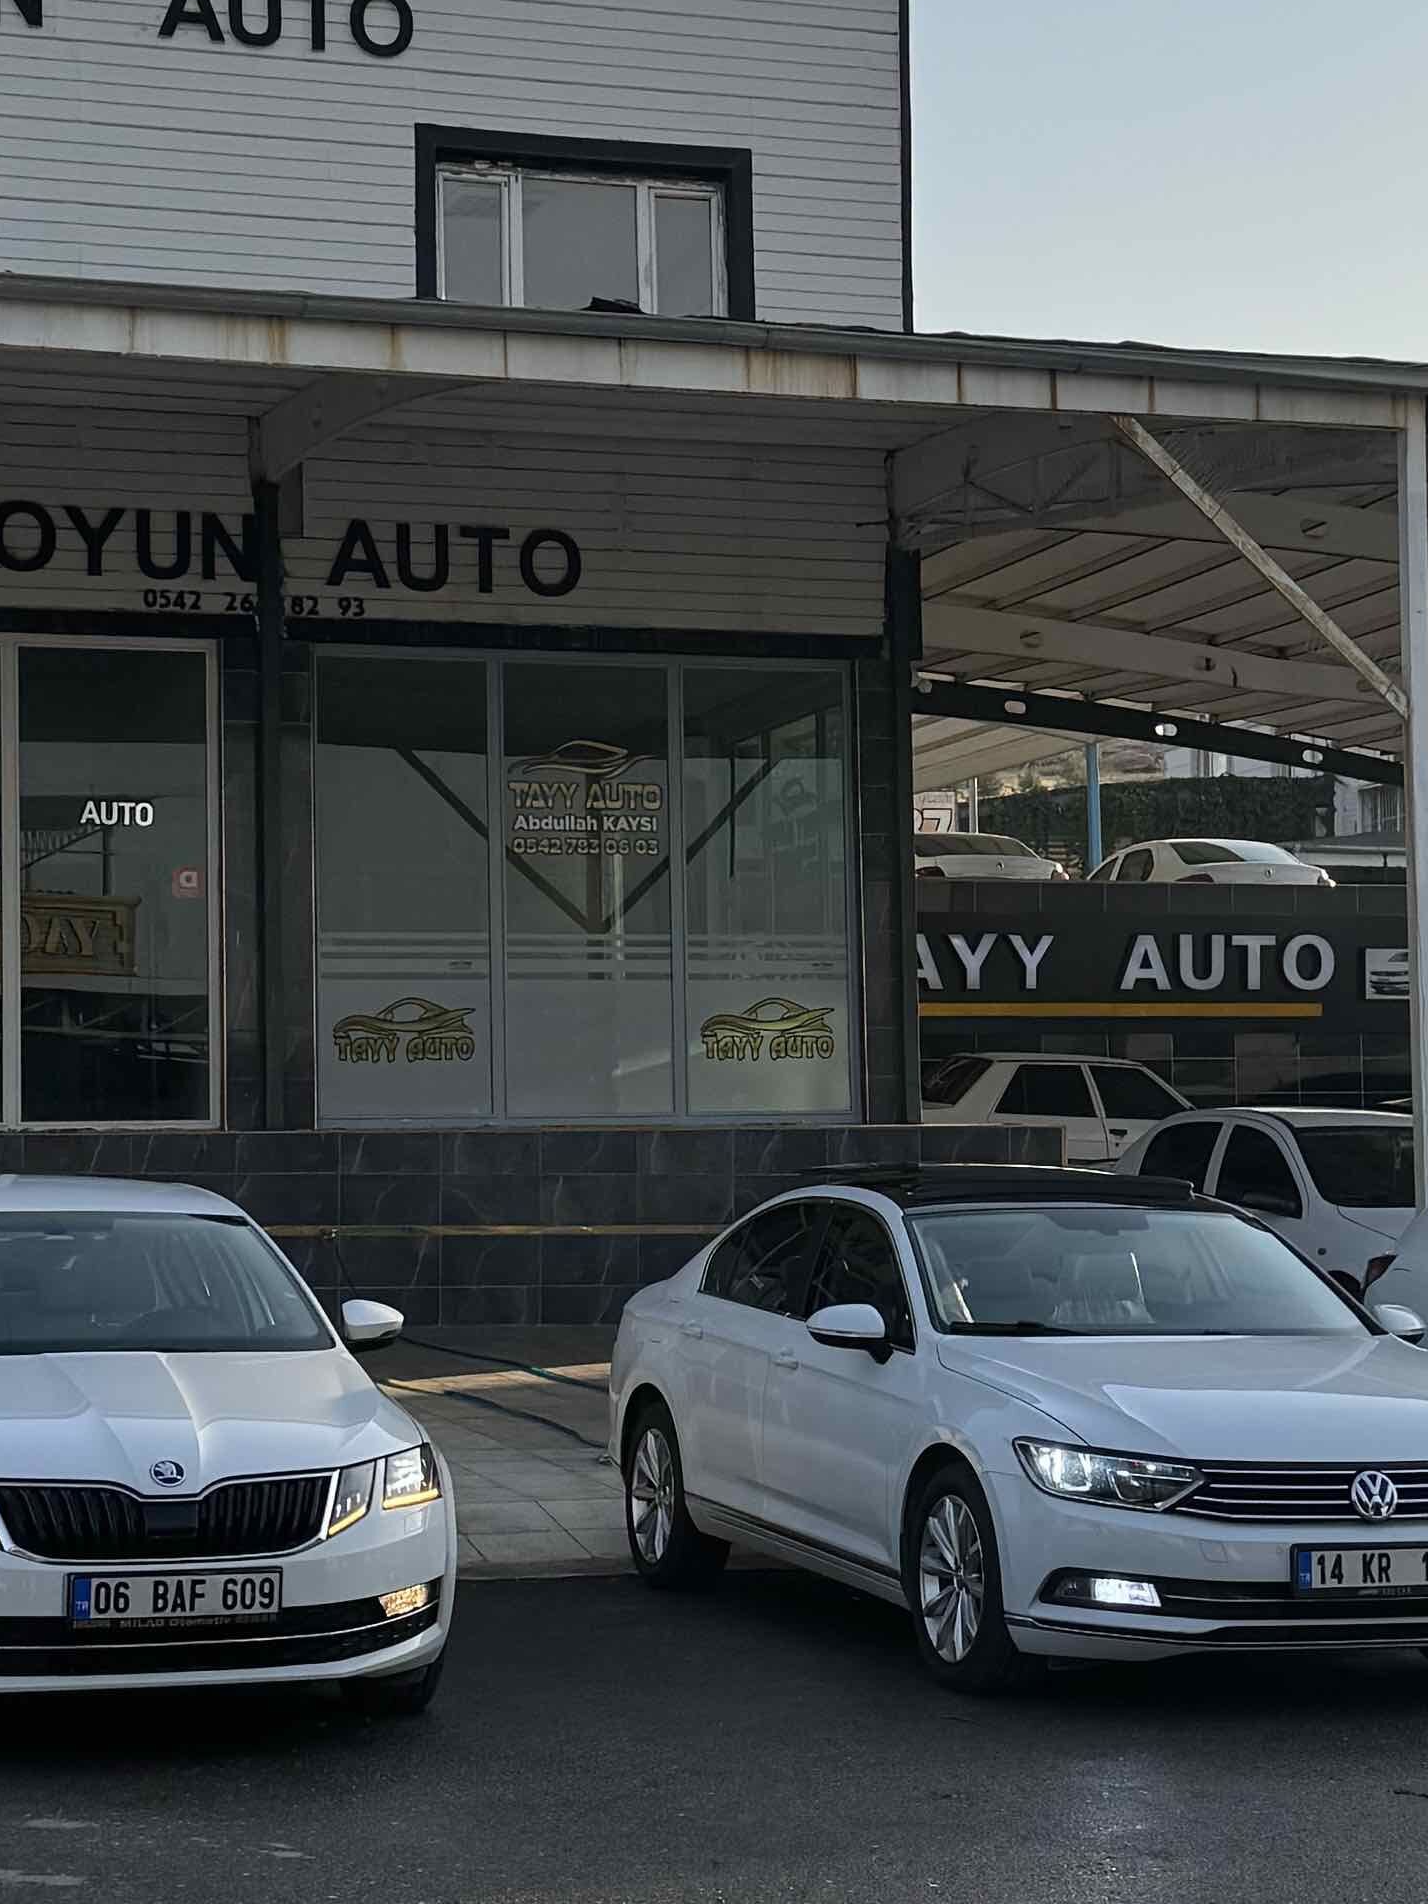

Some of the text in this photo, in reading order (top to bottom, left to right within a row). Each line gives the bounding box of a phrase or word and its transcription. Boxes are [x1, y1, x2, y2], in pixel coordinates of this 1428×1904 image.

[325, 518, 583, 597] AUTO
[143, 589, 366, 617] 0542 26 82 93
[508, 782, 662, 810] TAYY AUTO
[80, 801, 154, 827] AUTO
[514, 815, 598, 832] Abdullah
[513, 838, 562, 855] 0542
[1120, 934, 1336, 992] AUTO
[333, 1032, 476, 1064] TAYY AUTO
[701, 1032, 835, 1062] TAYY AUTO
[1317, 1553, 1344, 1584] 14
[1361, 1552, 1392, 1584] KR
[93, 1577, 276, 1615] 06 BAF 609
